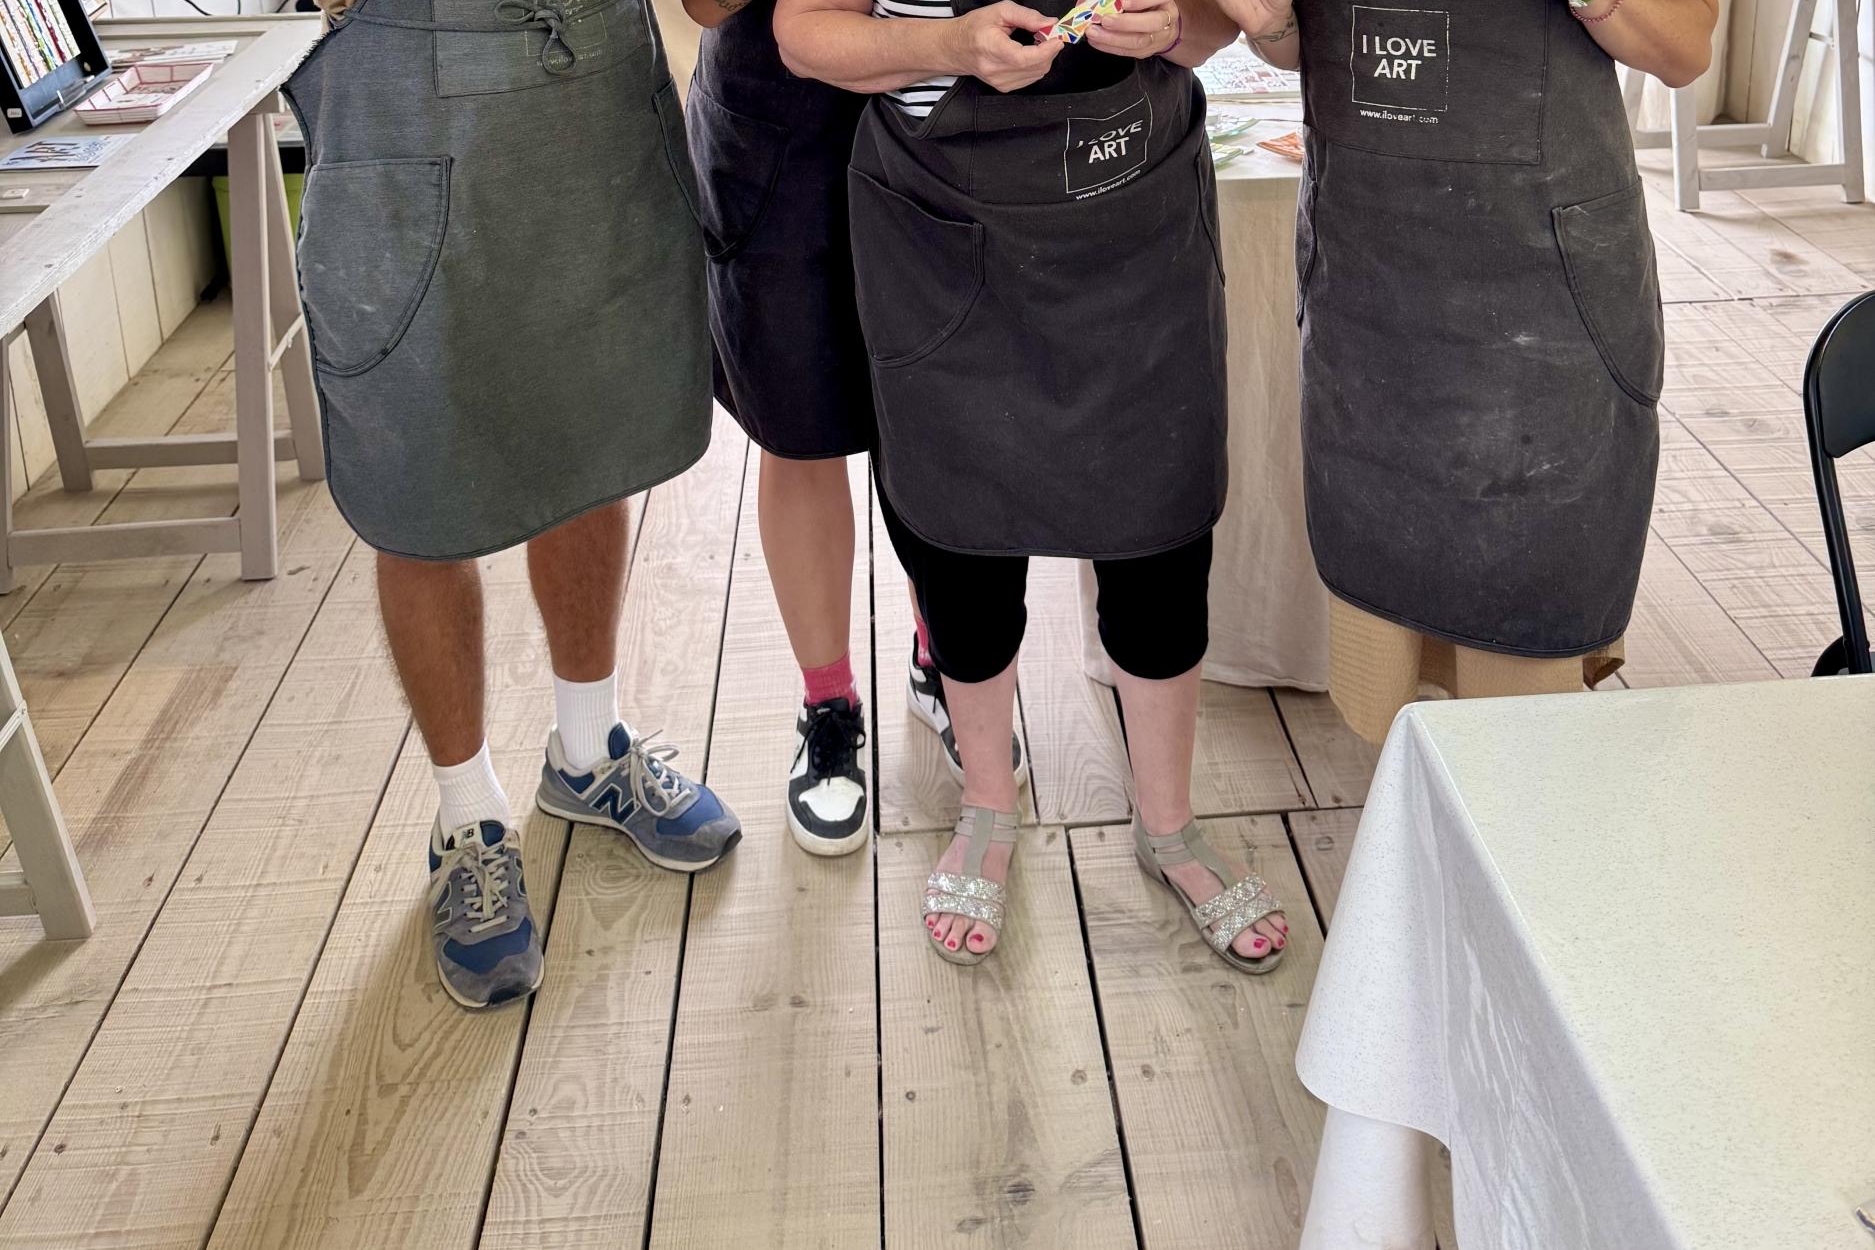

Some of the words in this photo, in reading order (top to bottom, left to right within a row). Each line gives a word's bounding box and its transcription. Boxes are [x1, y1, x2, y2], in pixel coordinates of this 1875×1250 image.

[1361, 34, 1368, 54] I
[1374, 36, 1437, 57] LOVE
[1373, 58, 1422, 80] ART
[1088, 136, 1130, 164] ART
[1075, 169, 1141, 201] www.iloveart.com
